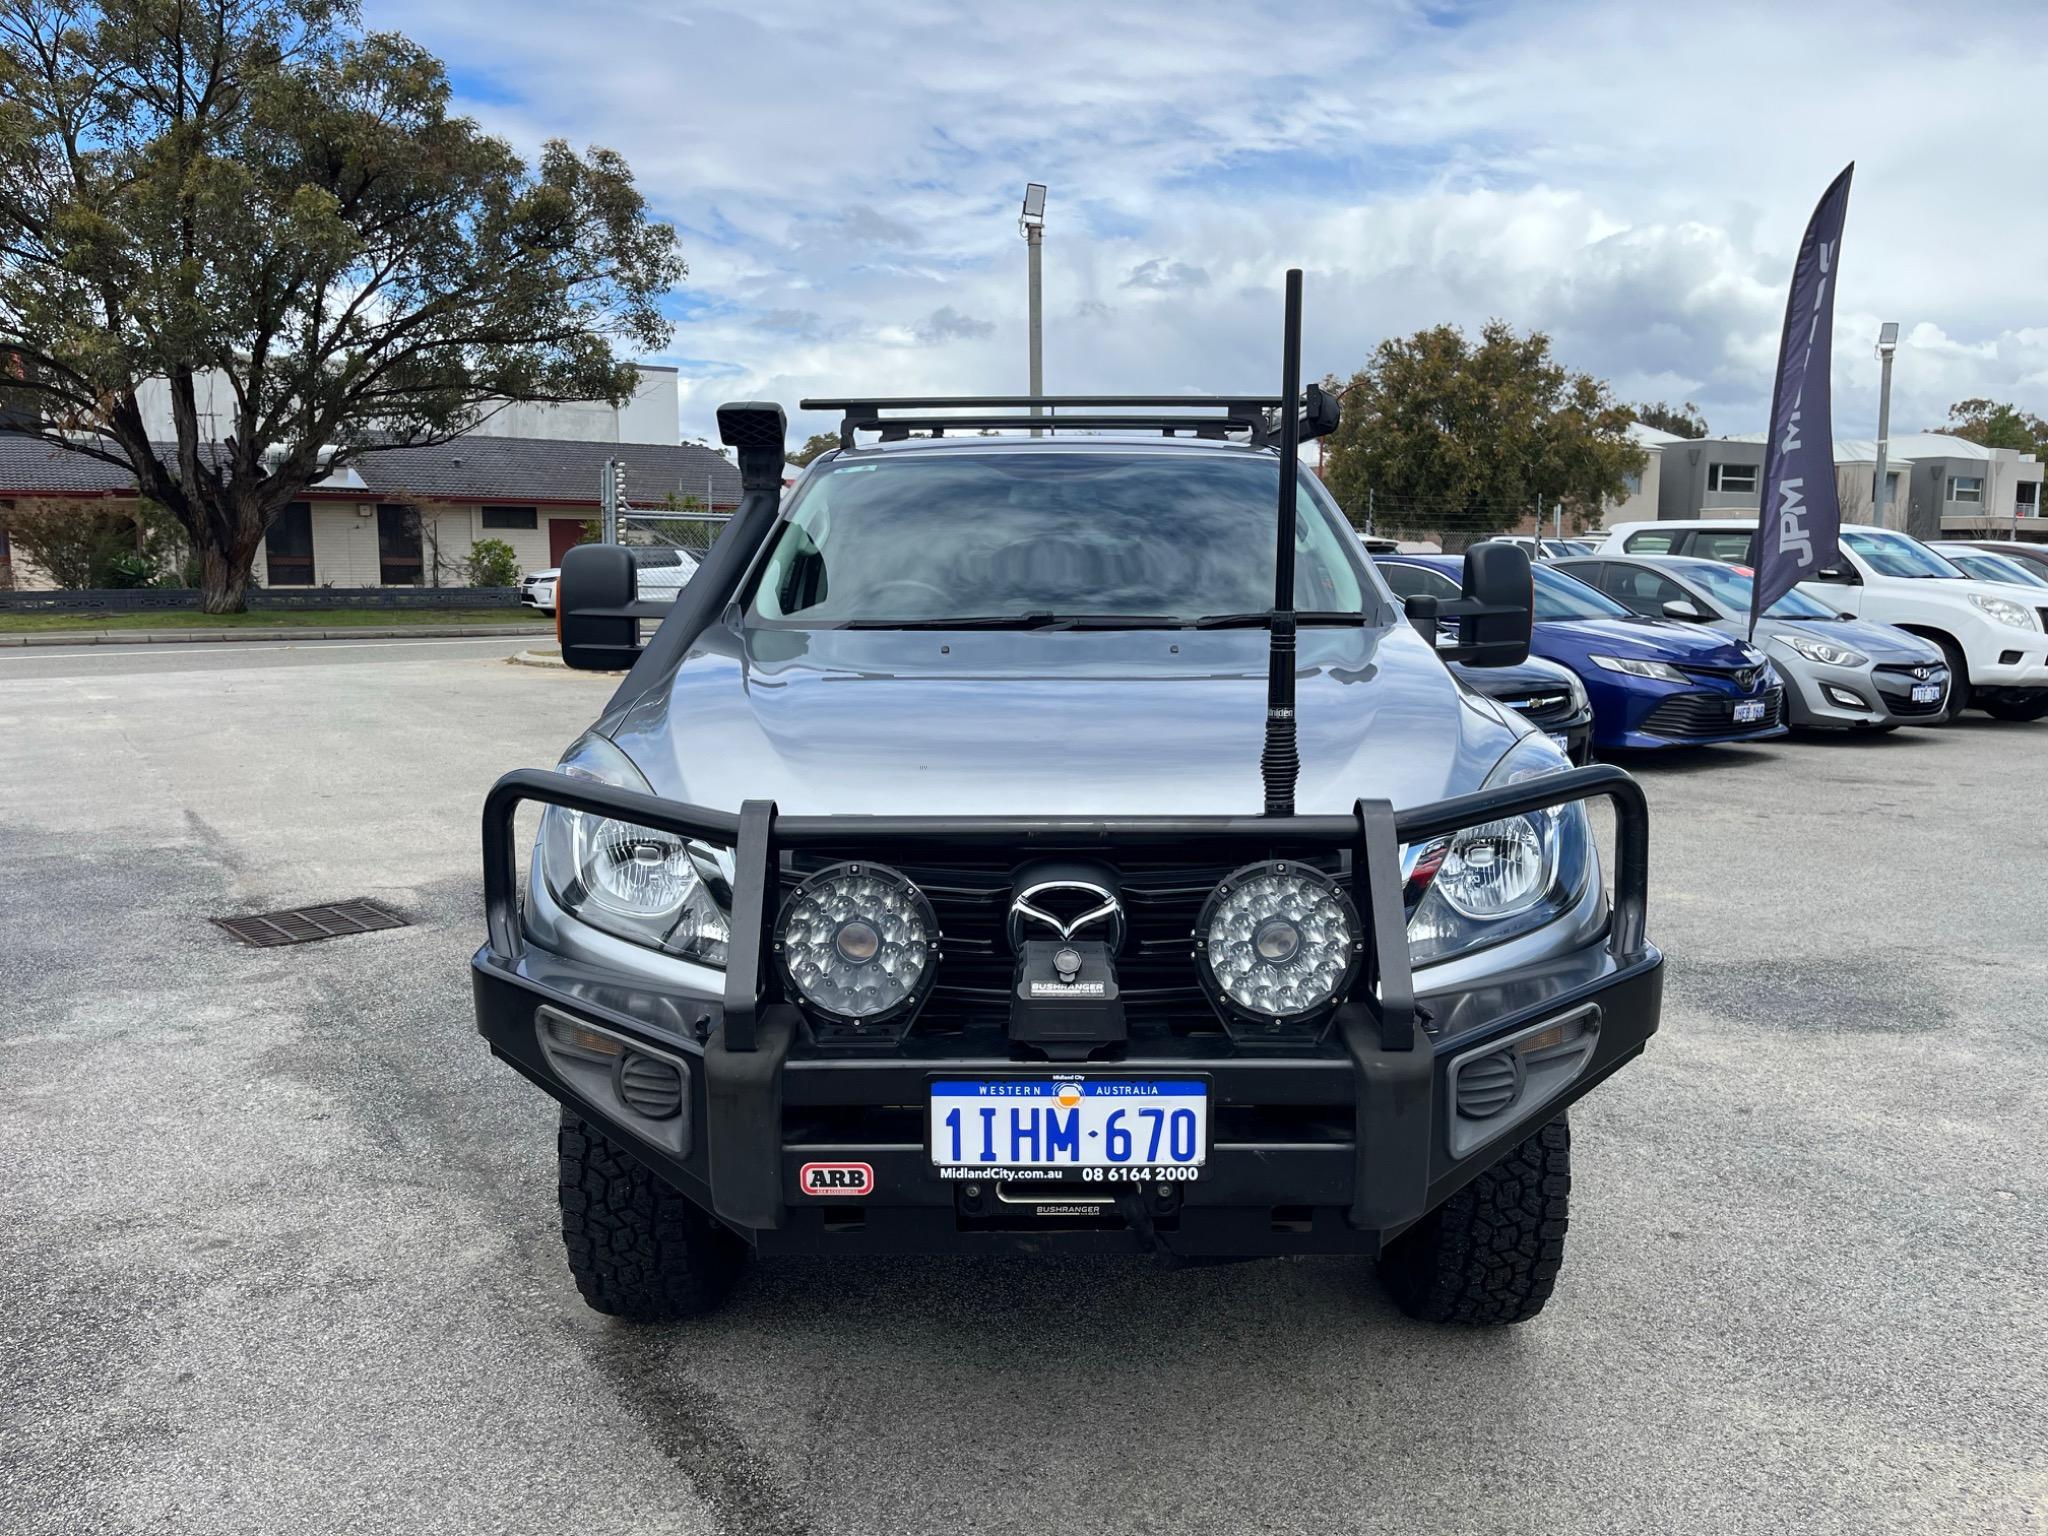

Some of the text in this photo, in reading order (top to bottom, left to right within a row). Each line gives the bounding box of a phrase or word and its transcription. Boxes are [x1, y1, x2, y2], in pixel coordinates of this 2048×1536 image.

[1779, 477, 1813, 567] JPM
[979, 1086, 1159, 1095] WESTERN AUSTRALIA
[809, 1169, 866, 1188] ARB
[940, 1167, 1199, 1181] MidlandCity.com.au 08 6164 2000
